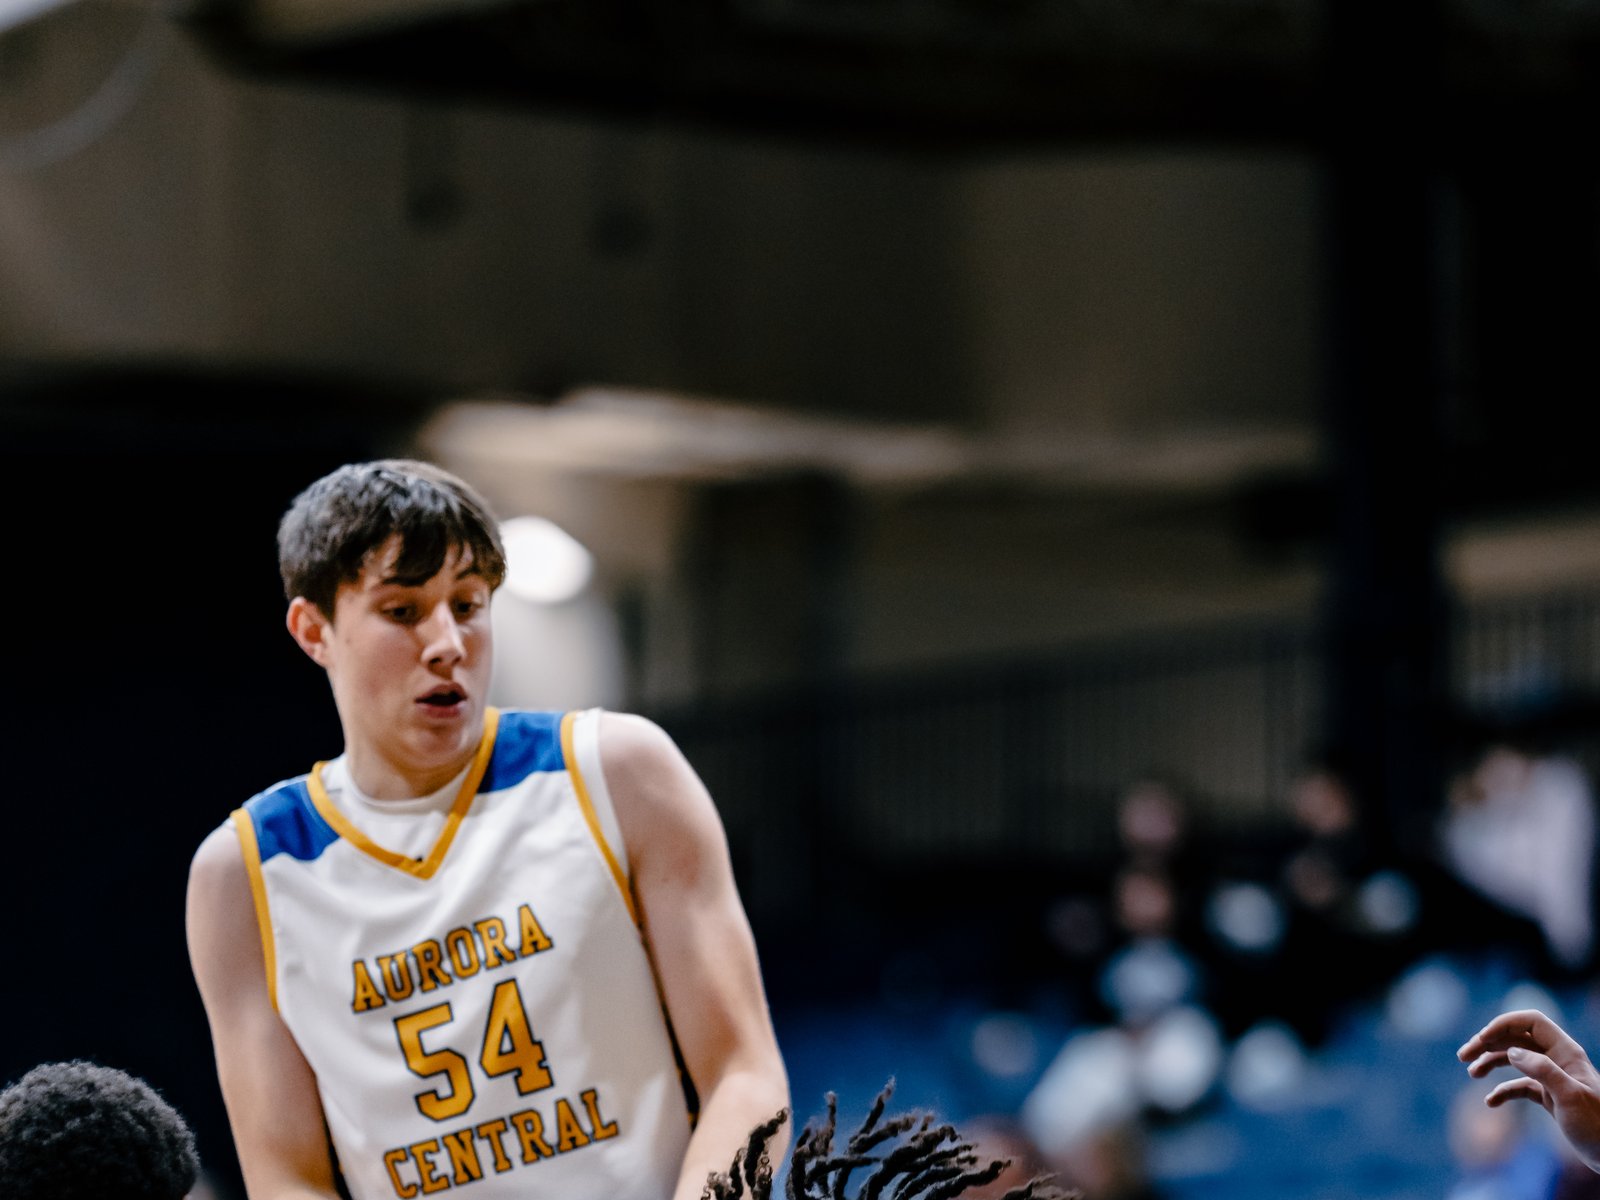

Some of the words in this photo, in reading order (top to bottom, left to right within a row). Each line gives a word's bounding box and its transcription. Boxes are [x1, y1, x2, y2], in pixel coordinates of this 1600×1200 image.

[352, 903, 554, 1014] AURORA
[393, 977, 554, 1123] 54
[383, 1088, 620, 1200] CENTRAL
